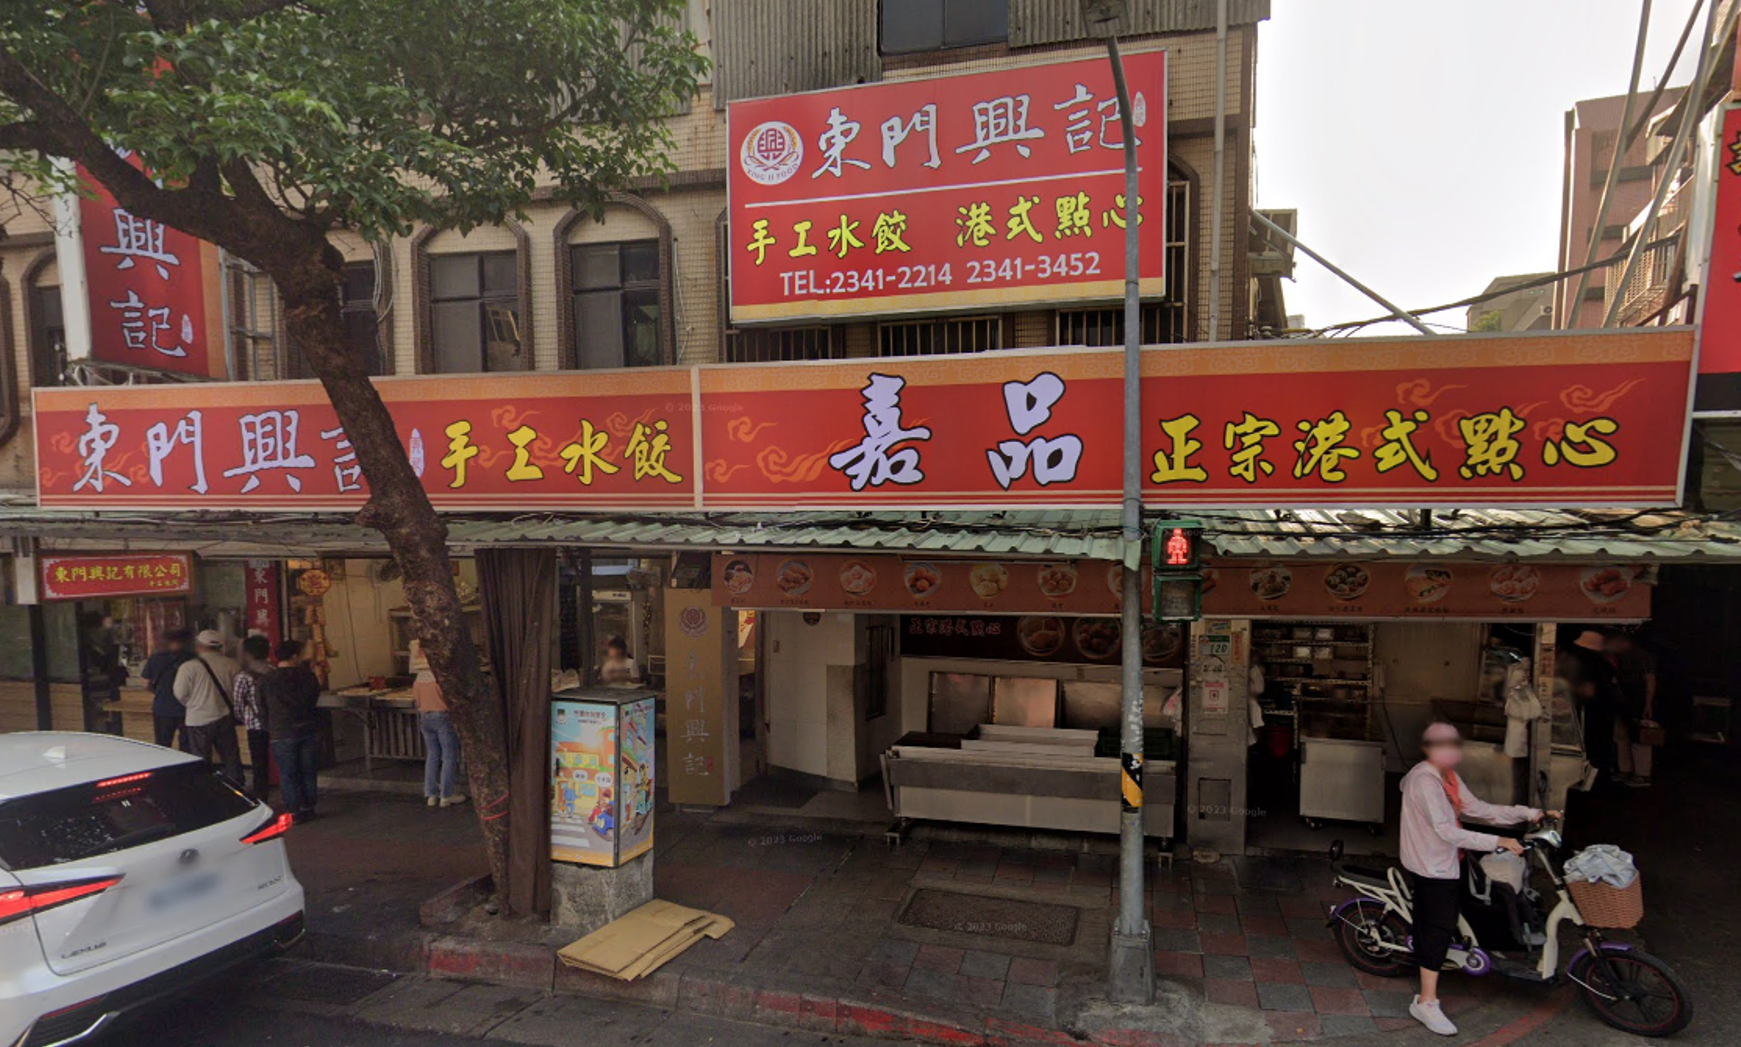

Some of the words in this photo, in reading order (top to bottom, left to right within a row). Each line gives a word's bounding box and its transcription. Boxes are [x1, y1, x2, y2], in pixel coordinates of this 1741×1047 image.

[811, 83, 1141, 180] 東門興記
[746, 210, 912, 267] 手工水餃
[955, 190, 1144, 249] 港式點心
[779, 262, 953, 297] TEL:2341-2214
[966, 252, 1101, 285] 2341-3452
[441, 418, 683, 489] 手工水餃
[828, 371, 1084, 491] 嘉品
[1150, 406, 1619, 485] 正宗港式點心
[55, 562, 182, 583] 東門興記有限公司
